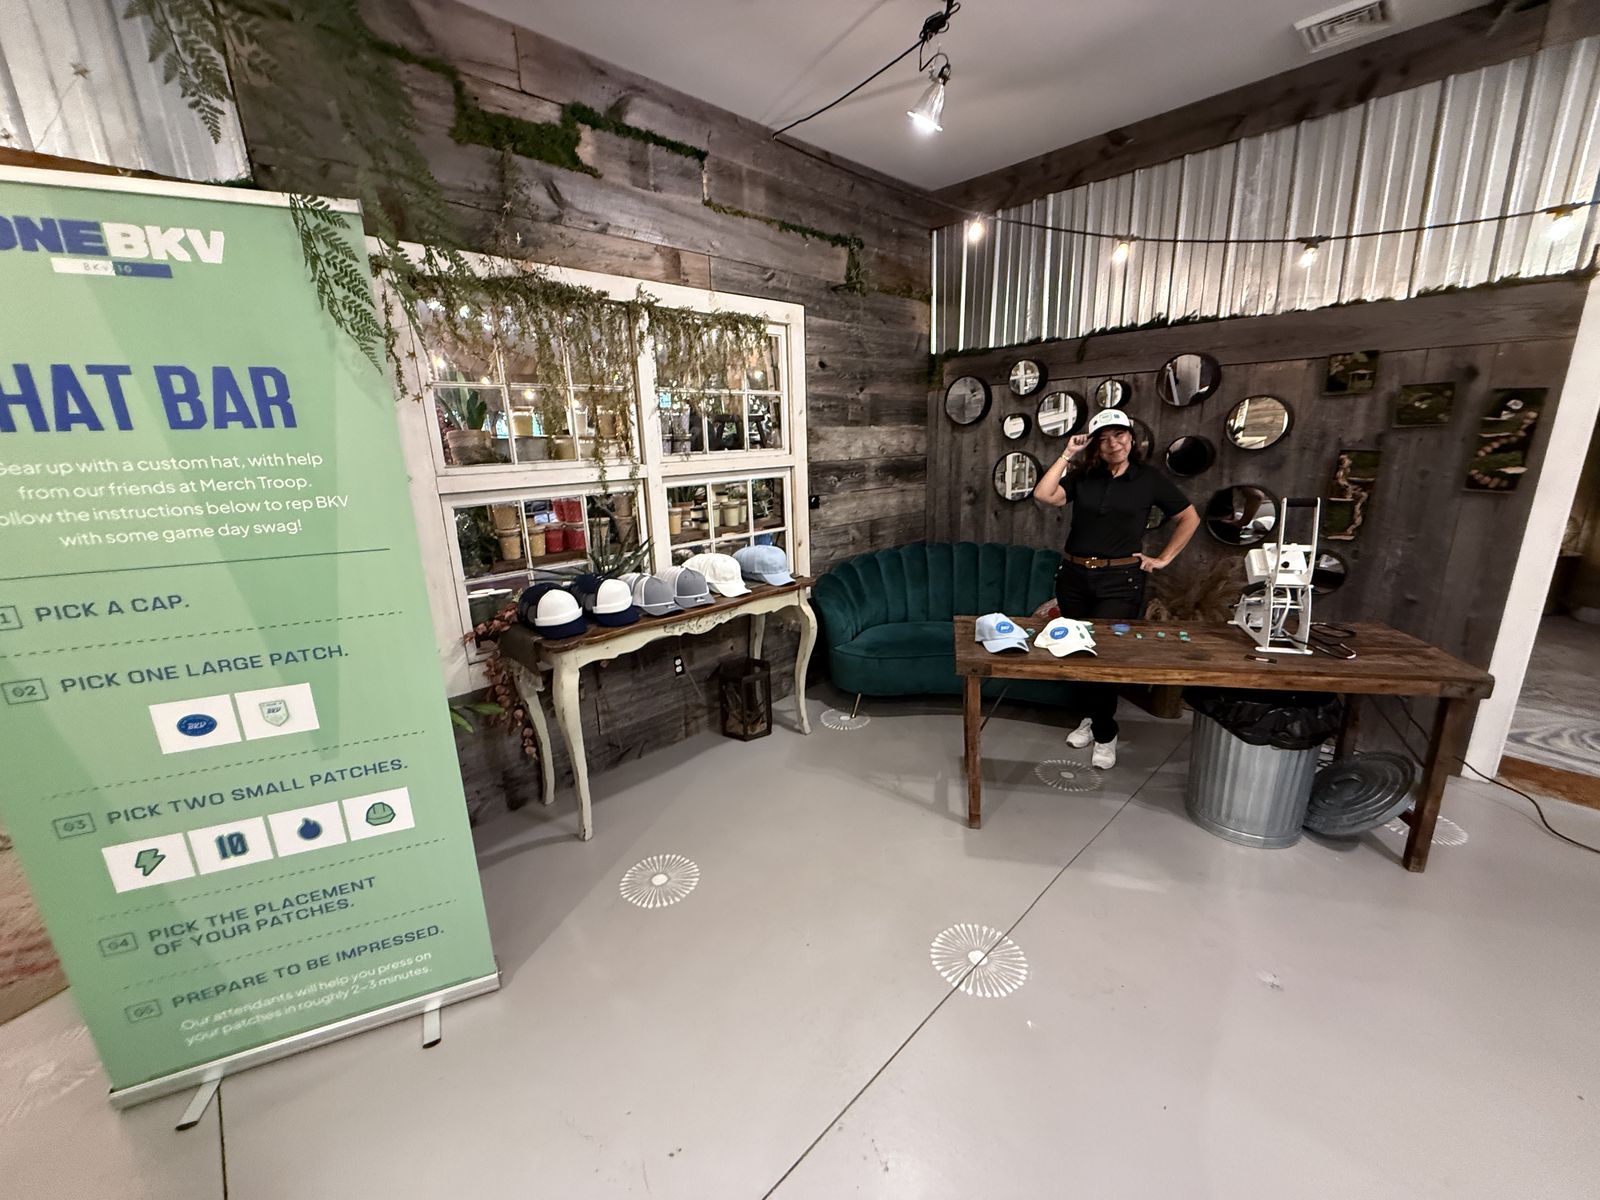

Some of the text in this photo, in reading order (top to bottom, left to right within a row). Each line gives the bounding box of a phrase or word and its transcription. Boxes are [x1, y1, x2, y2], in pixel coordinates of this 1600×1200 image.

[0, 363, 297, 432] HAT BAR
[46, 462, 73, 476] up
[76, 459, 119, 473] with
[122, 461, 134, 472] a
[137, 456, 208, 472] custom
[210, 456, 245, 469] hat,
[248, 453, 284, 467] with
[286, 452, 323, 468] help
[17, 476, 312, 500] from our friends at Merch Troop.
[0, 495, 348, 527] ollow the instructions below to rep BKV
[59, 519, 302, 547] with some game day swag!
[0, 613, 11, 624] 1
[34, 595, 190, 622] PICK A CAP.
[60, 645, 349, 693] PICK ONE LARGE PATCH.
[12, 685, 37, 698] 02
[107, 759, 408, 824] PICK TWO SMALL PATCHES.
[63, 819, 86, 832] 03
[148, 876, 376, 941] PICK THE PLACEMENT
[154, 898, 355, 956] OF YOUR PATCHES.
[172, 925, 445, 1008] PREPARE TO BE IMPRESSED.
[179, 952, 432, 1031] Our attendants will help you press on
[185, 1027, 218, 1047] your
[222, 1008, 282, 1035] patches
[285, 1002, 297, 1015] in
[298, 988, 350, 1011] roughly
[378, 965, 433, 985] minutes.
